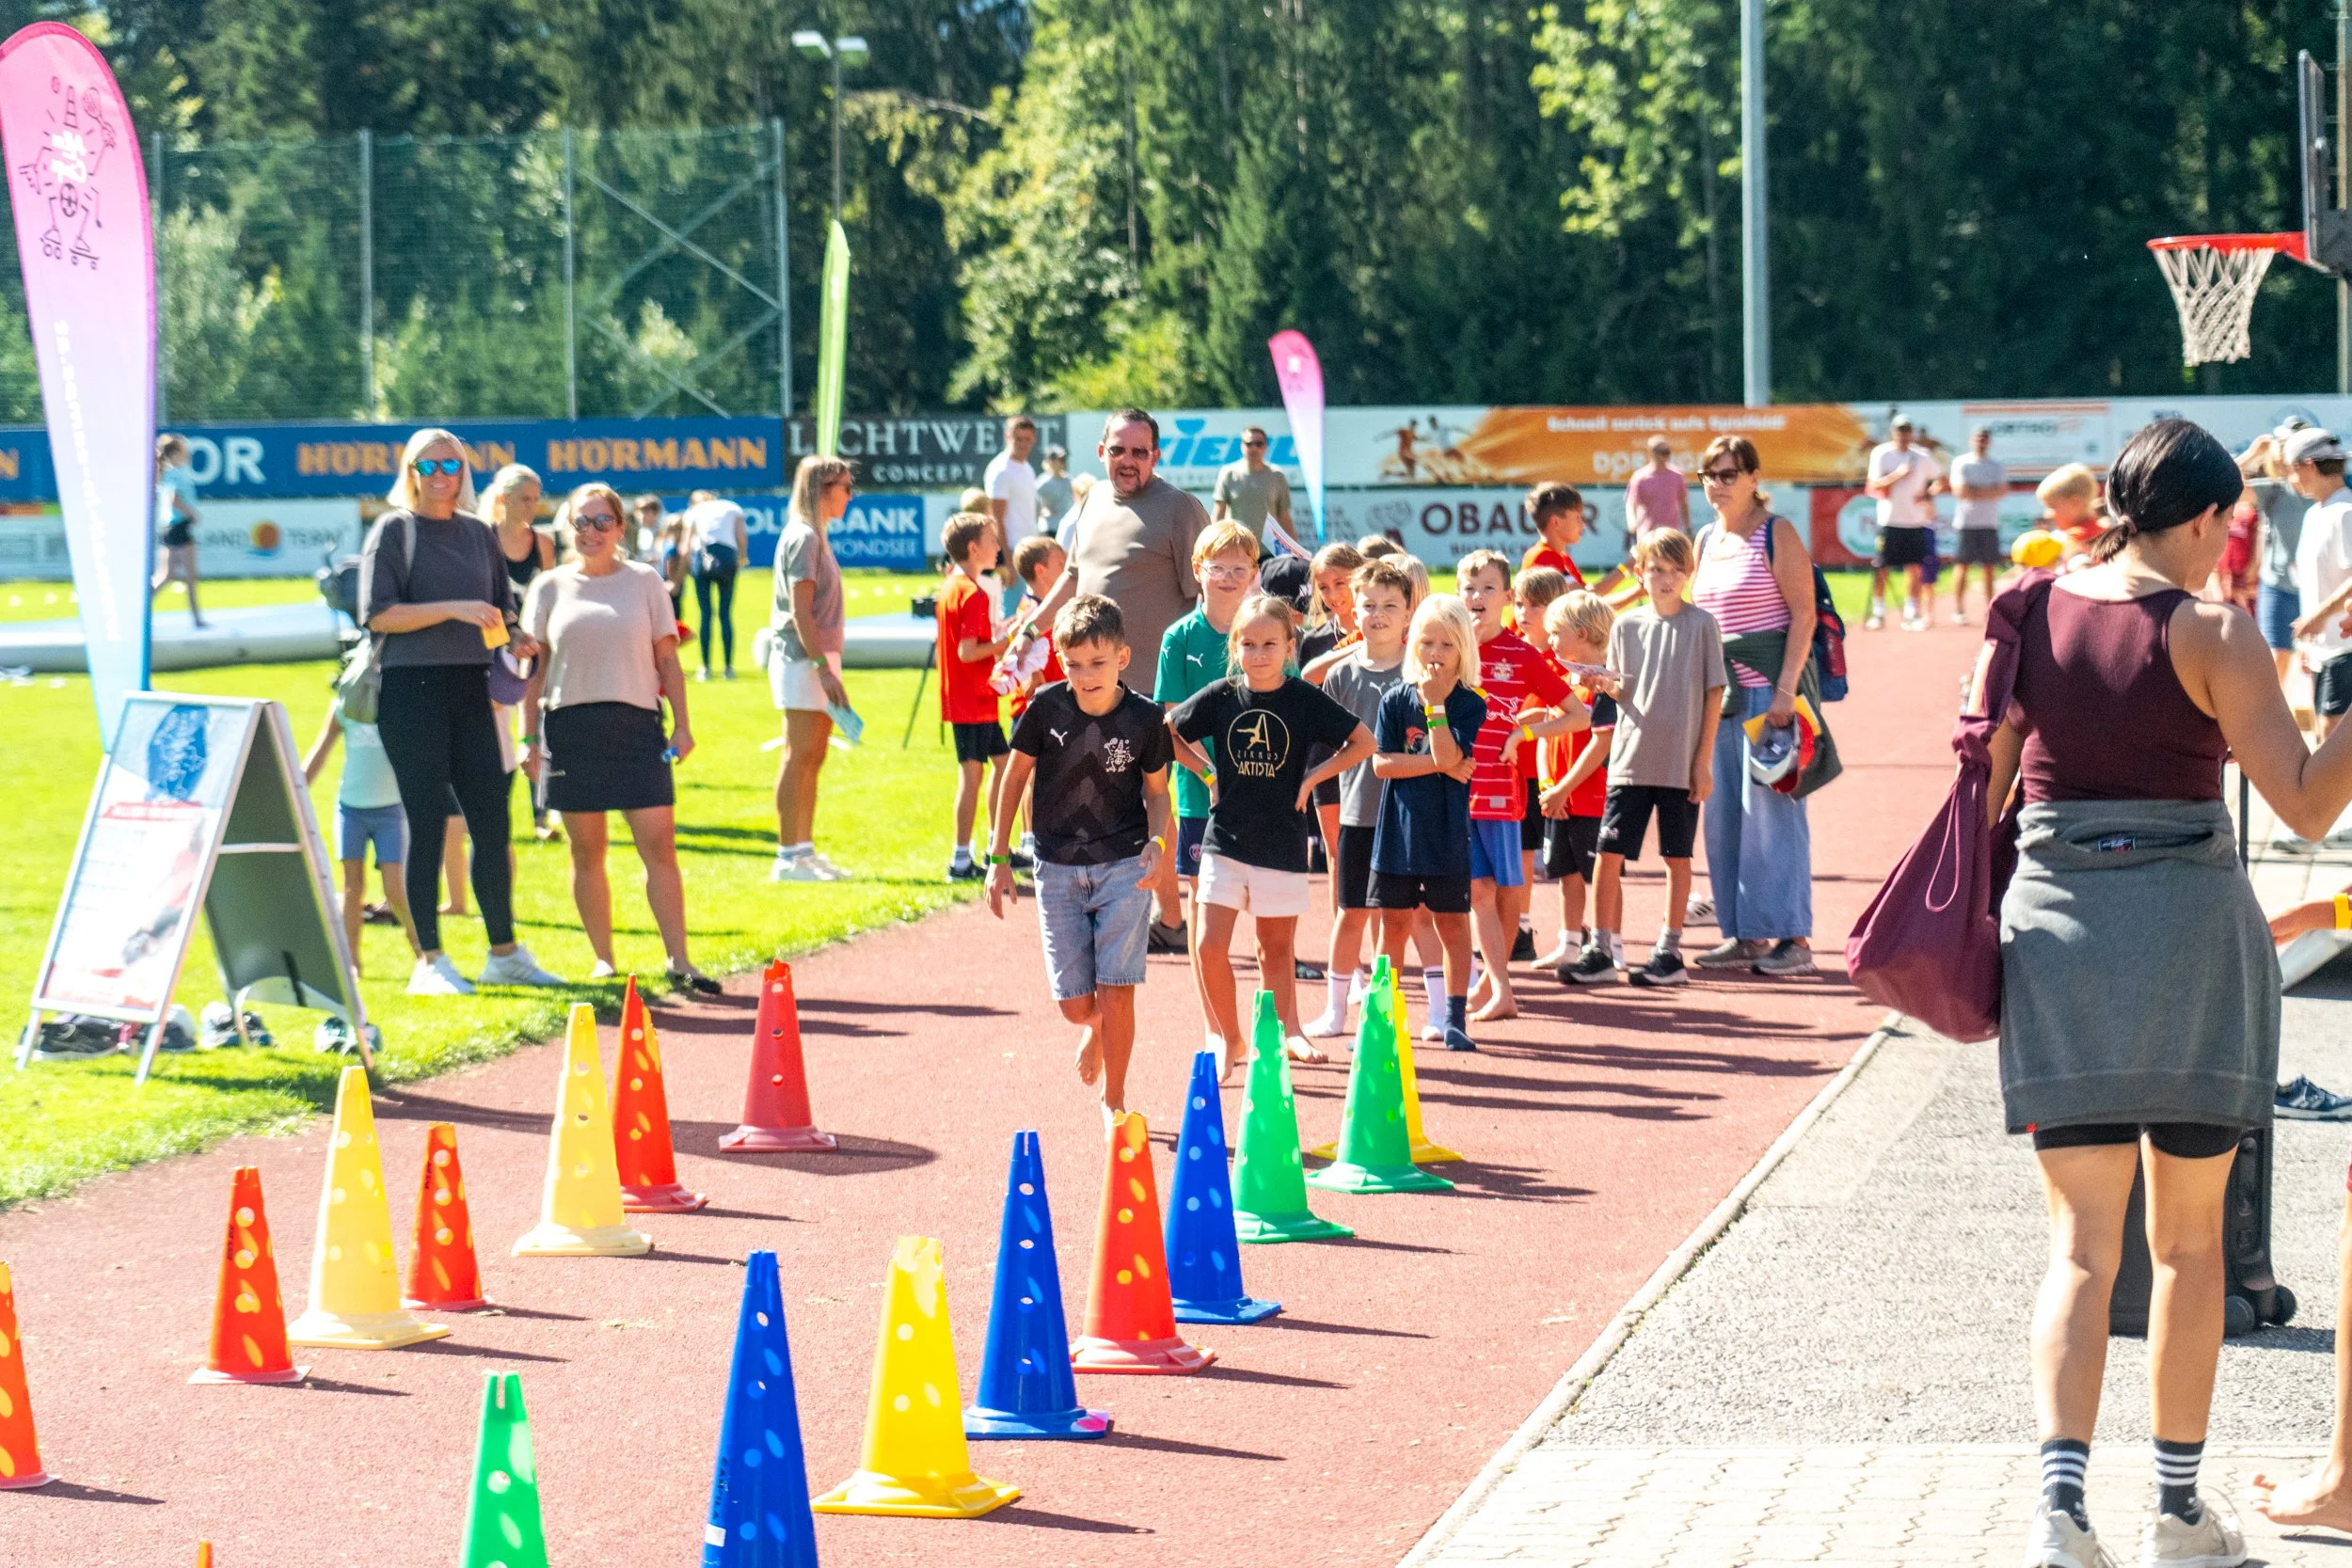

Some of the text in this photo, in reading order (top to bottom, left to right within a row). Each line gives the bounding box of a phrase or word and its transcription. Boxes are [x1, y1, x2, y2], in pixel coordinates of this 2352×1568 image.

[788, 420, 1060, 456] LCHTWET
[188, 436, 267, 485] OR
[871, 462, 976, 483] CONCEPT
[740, 507, 920, 534] OLBANK
[1421, 500, 1598, 535] OBAUR
[1237, 760, 1276, 778] ARTISTA
